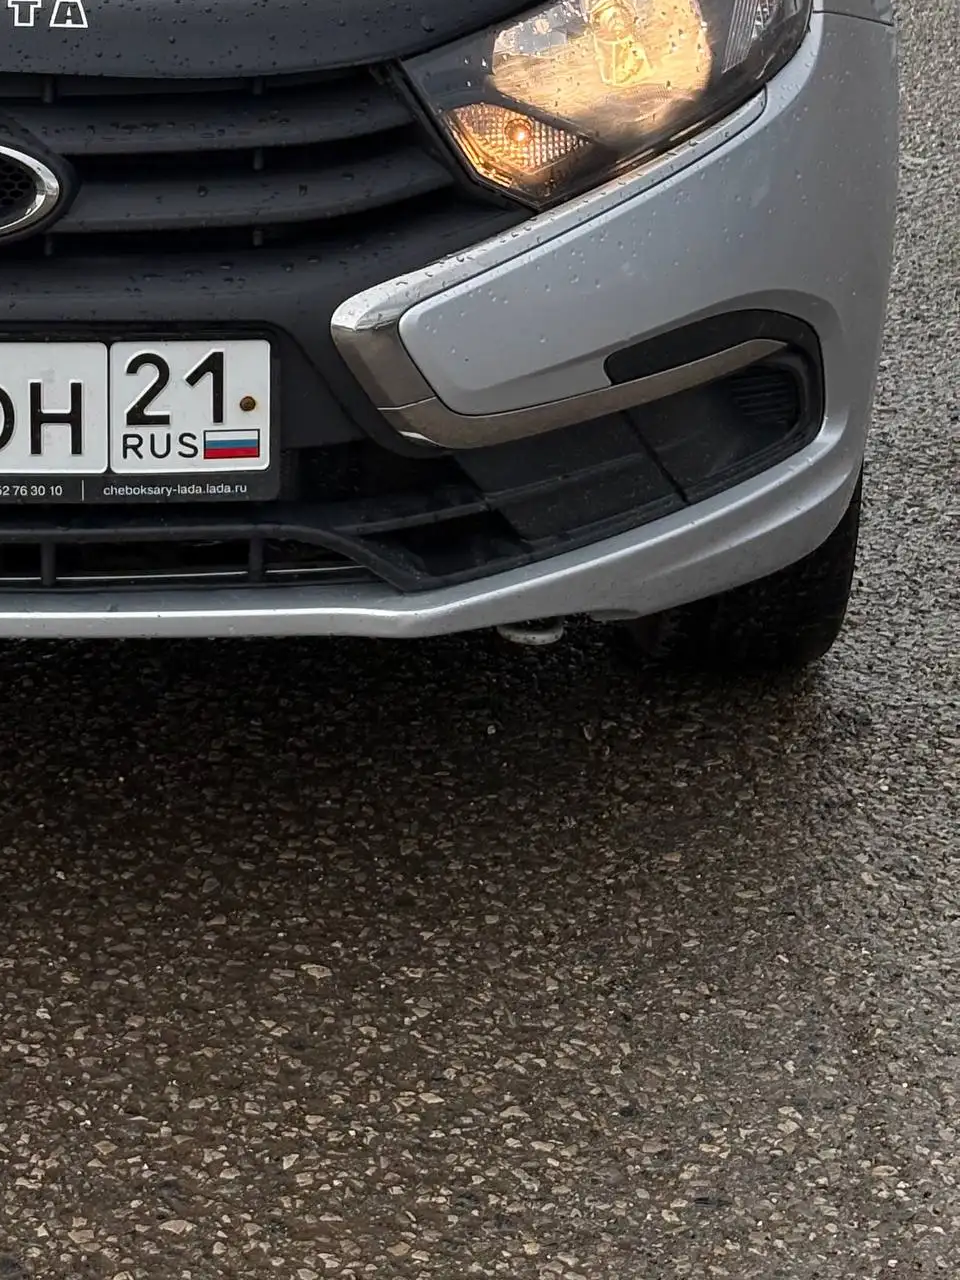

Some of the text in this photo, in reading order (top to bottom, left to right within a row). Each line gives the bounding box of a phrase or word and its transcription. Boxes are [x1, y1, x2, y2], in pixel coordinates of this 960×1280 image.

[125, 351, 225, 426] 21
[122, 432, 199, 460] RUS
[12, 484, 28, 497] 76
[30, 484, 46, 497] 30
[49, 484, 63, 497] 10
[102, 482, 248, 497] cheboksary-lada.lada.ru
